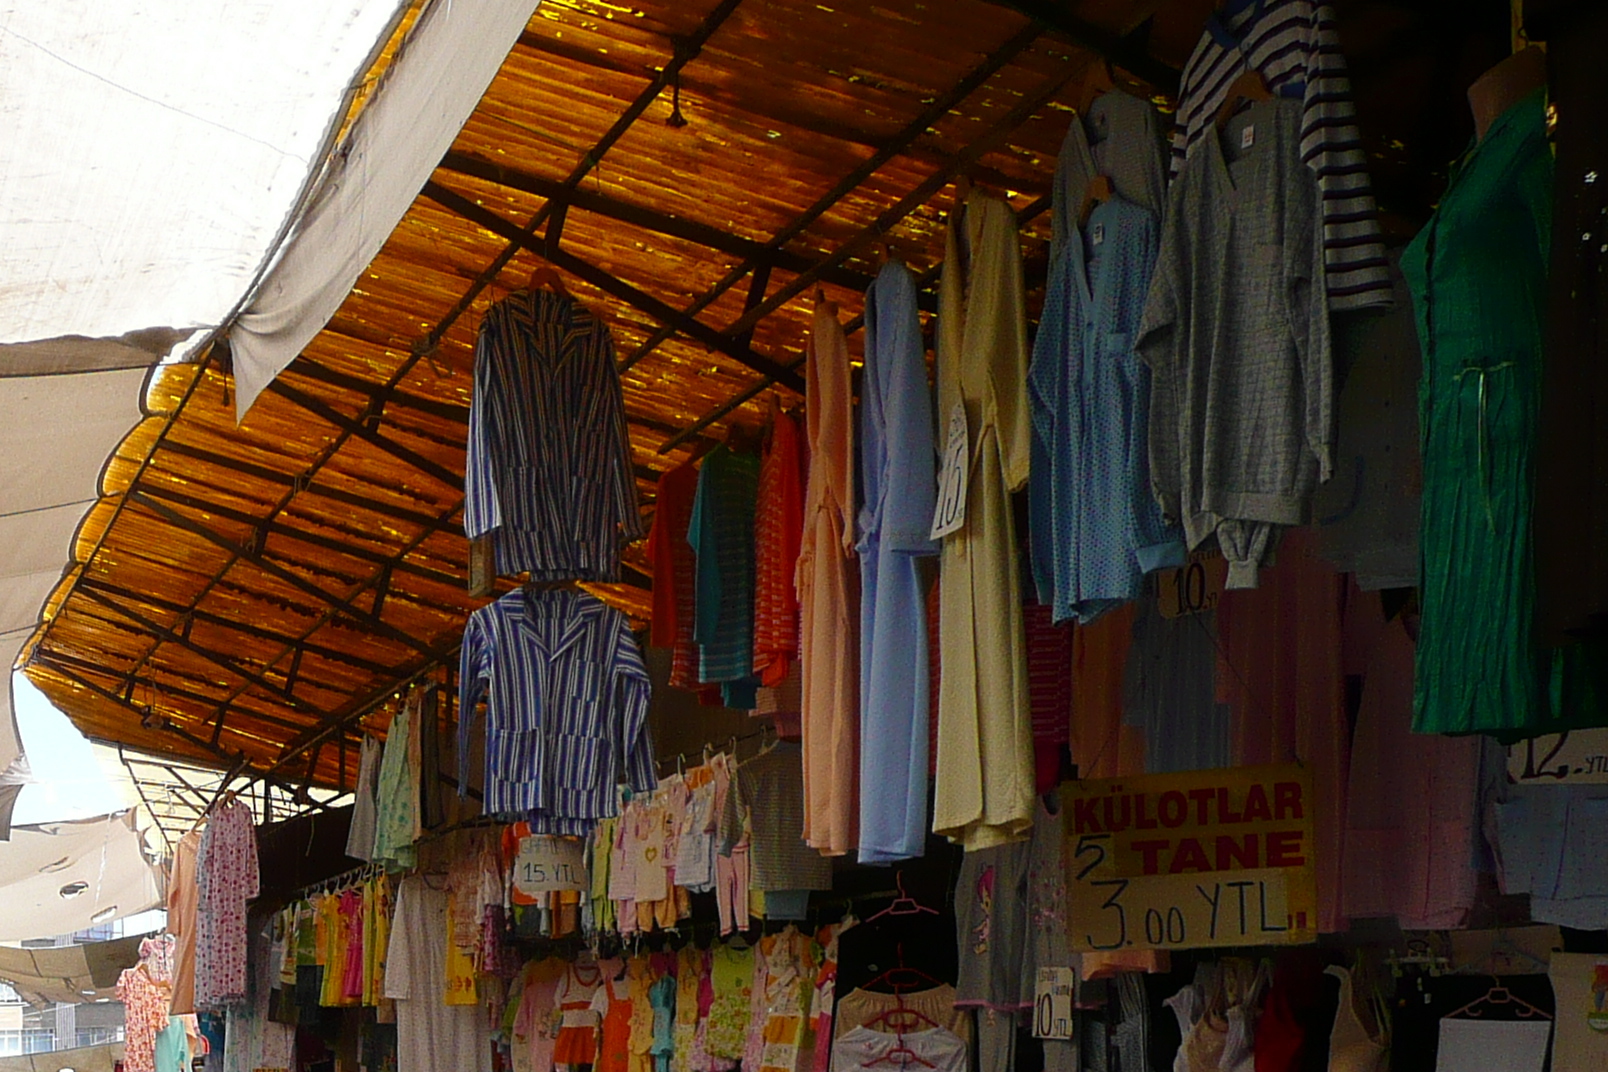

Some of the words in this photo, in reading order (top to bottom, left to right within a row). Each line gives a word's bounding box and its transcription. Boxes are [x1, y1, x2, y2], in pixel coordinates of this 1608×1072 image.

[1074, 781, 1304, 834] KÜLOTLAR
[552, 862, 581, 885] YTL
[1074, 833, 1111, 879] 5
[1131, 833, 1305, 875] TANE
[1196, 881, 1289, 940] YTL
